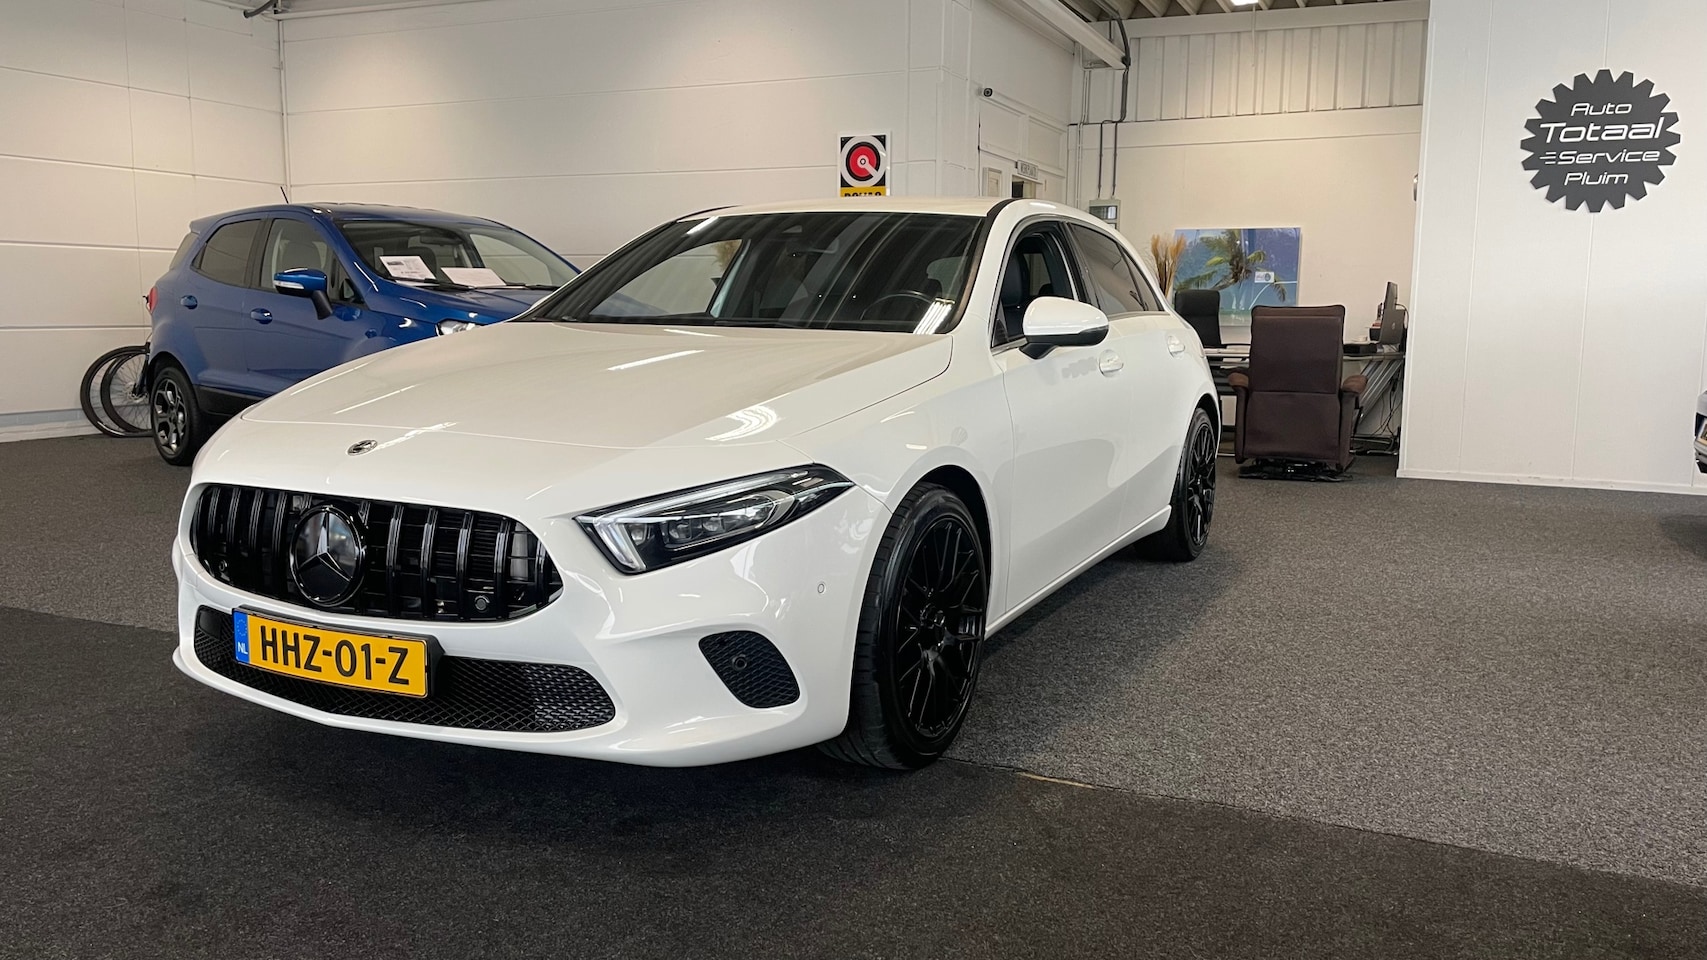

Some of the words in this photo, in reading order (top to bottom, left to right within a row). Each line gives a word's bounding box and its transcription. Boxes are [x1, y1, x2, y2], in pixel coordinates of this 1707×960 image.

[1570, 102, 1633, 117] Auto
[1539, 116, 1665, 144] Totaal
[1557, 149, 1661, 165] Service
[1564, 171, 1629, 186] Pluim
[237, 641, 249, 655] NL
[260, 625, 410, 685] HHZ-01-Z
